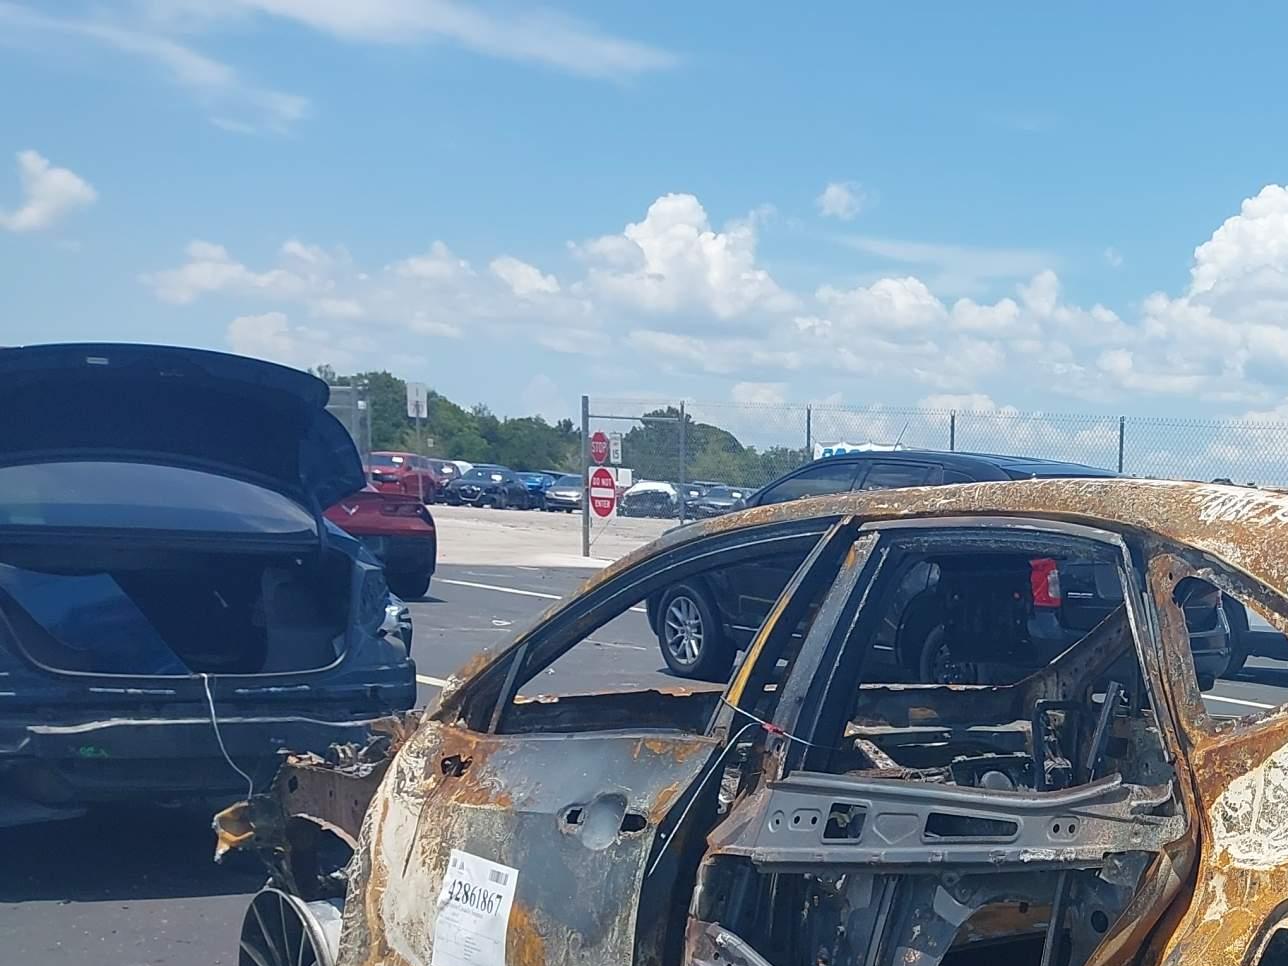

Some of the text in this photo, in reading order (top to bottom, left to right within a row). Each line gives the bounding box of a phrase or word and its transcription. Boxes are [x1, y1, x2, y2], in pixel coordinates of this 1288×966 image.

[592, 441, 607, 453] STOP
[612, 449, 620, 459] 15
[592, 477, 612, 487] DO NOT
[594, 500, 611, 508] ENTER
[448, 878, 503, 917] 42861867
